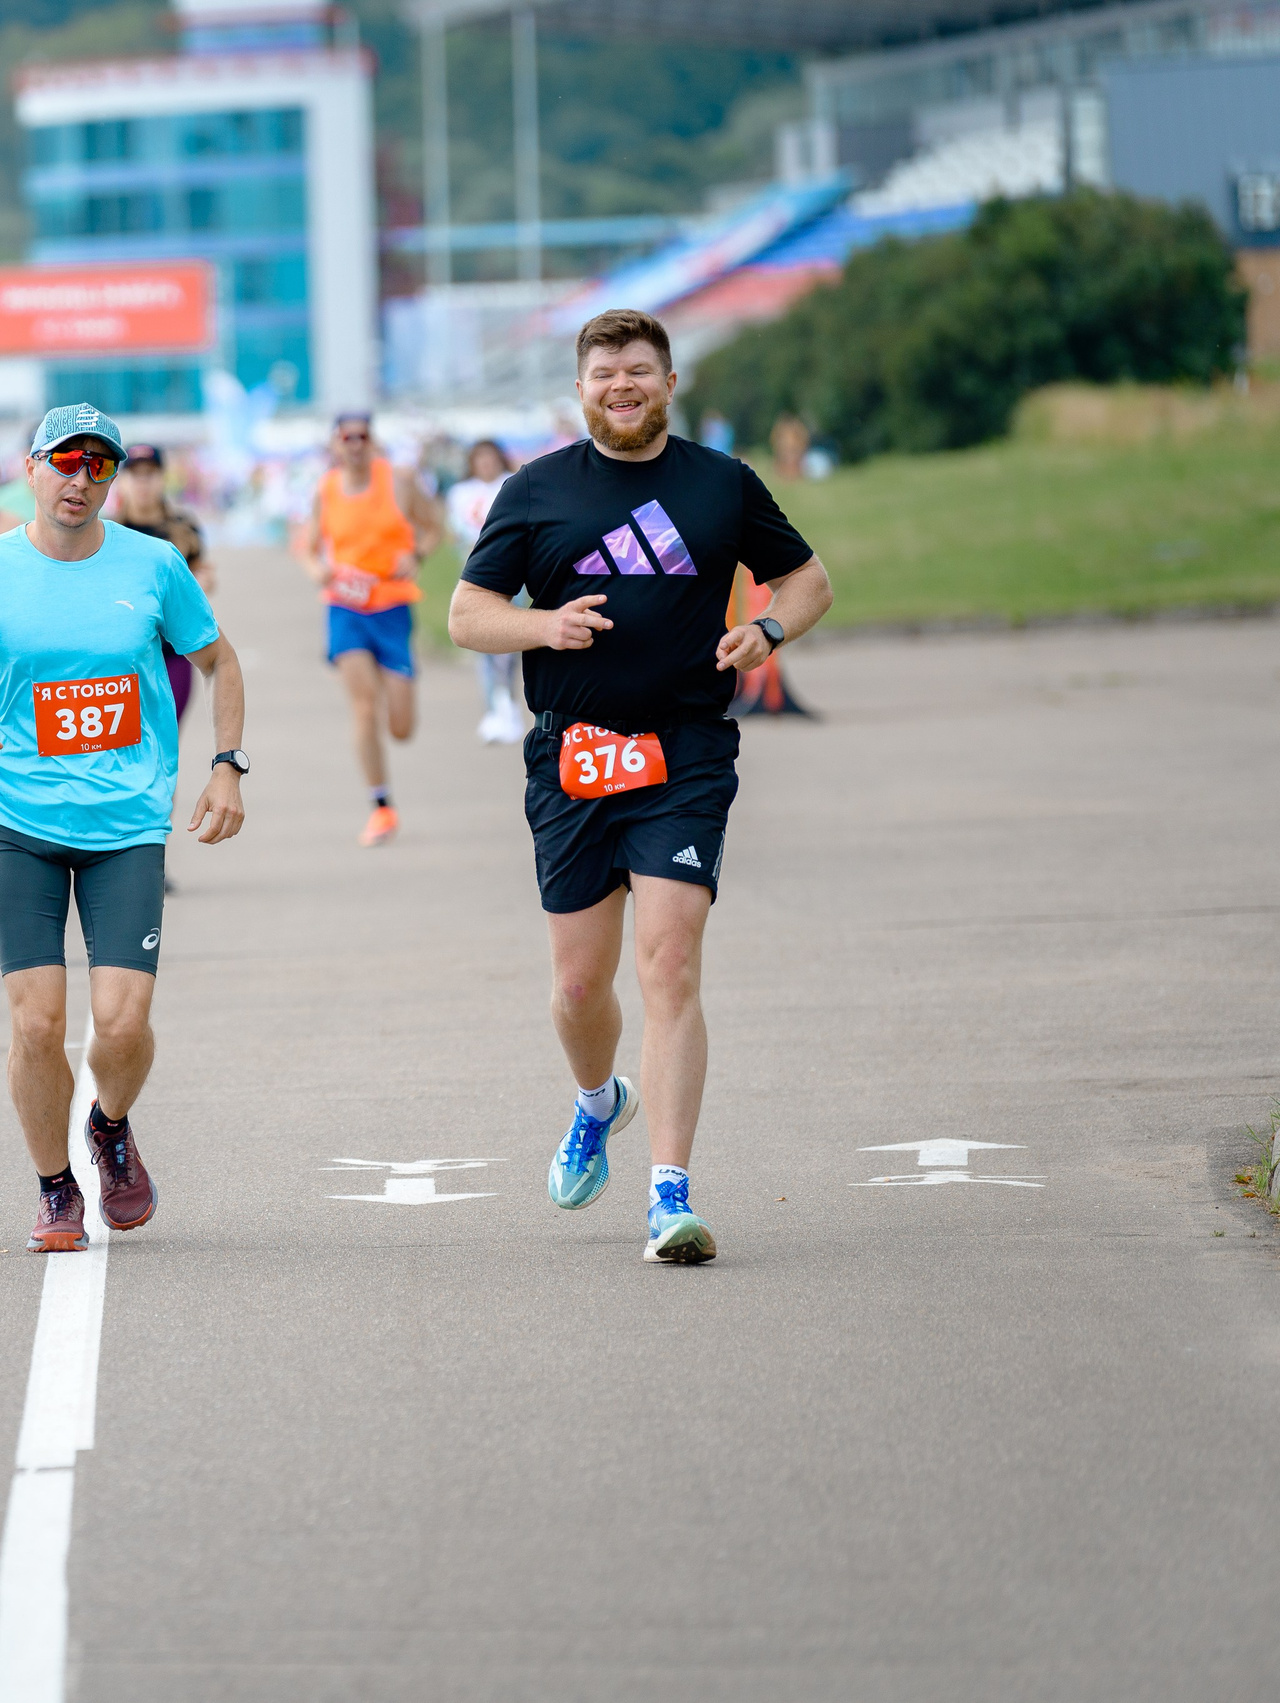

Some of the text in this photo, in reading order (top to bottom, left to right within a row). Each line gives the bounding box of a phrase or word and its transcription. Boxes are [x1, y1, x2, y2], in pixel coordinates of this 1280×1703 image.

[41, 677, 132, 701] Я С ТОБОЙ
[55, 703, 125, 741] 387
[572, 728, 583, 743] С
[80, 743, 90, 751] 10
[574, 739, 646, 785] 376
[603, 782, 626, 793] 10 км
[672, 855, 702, 868] adidas
